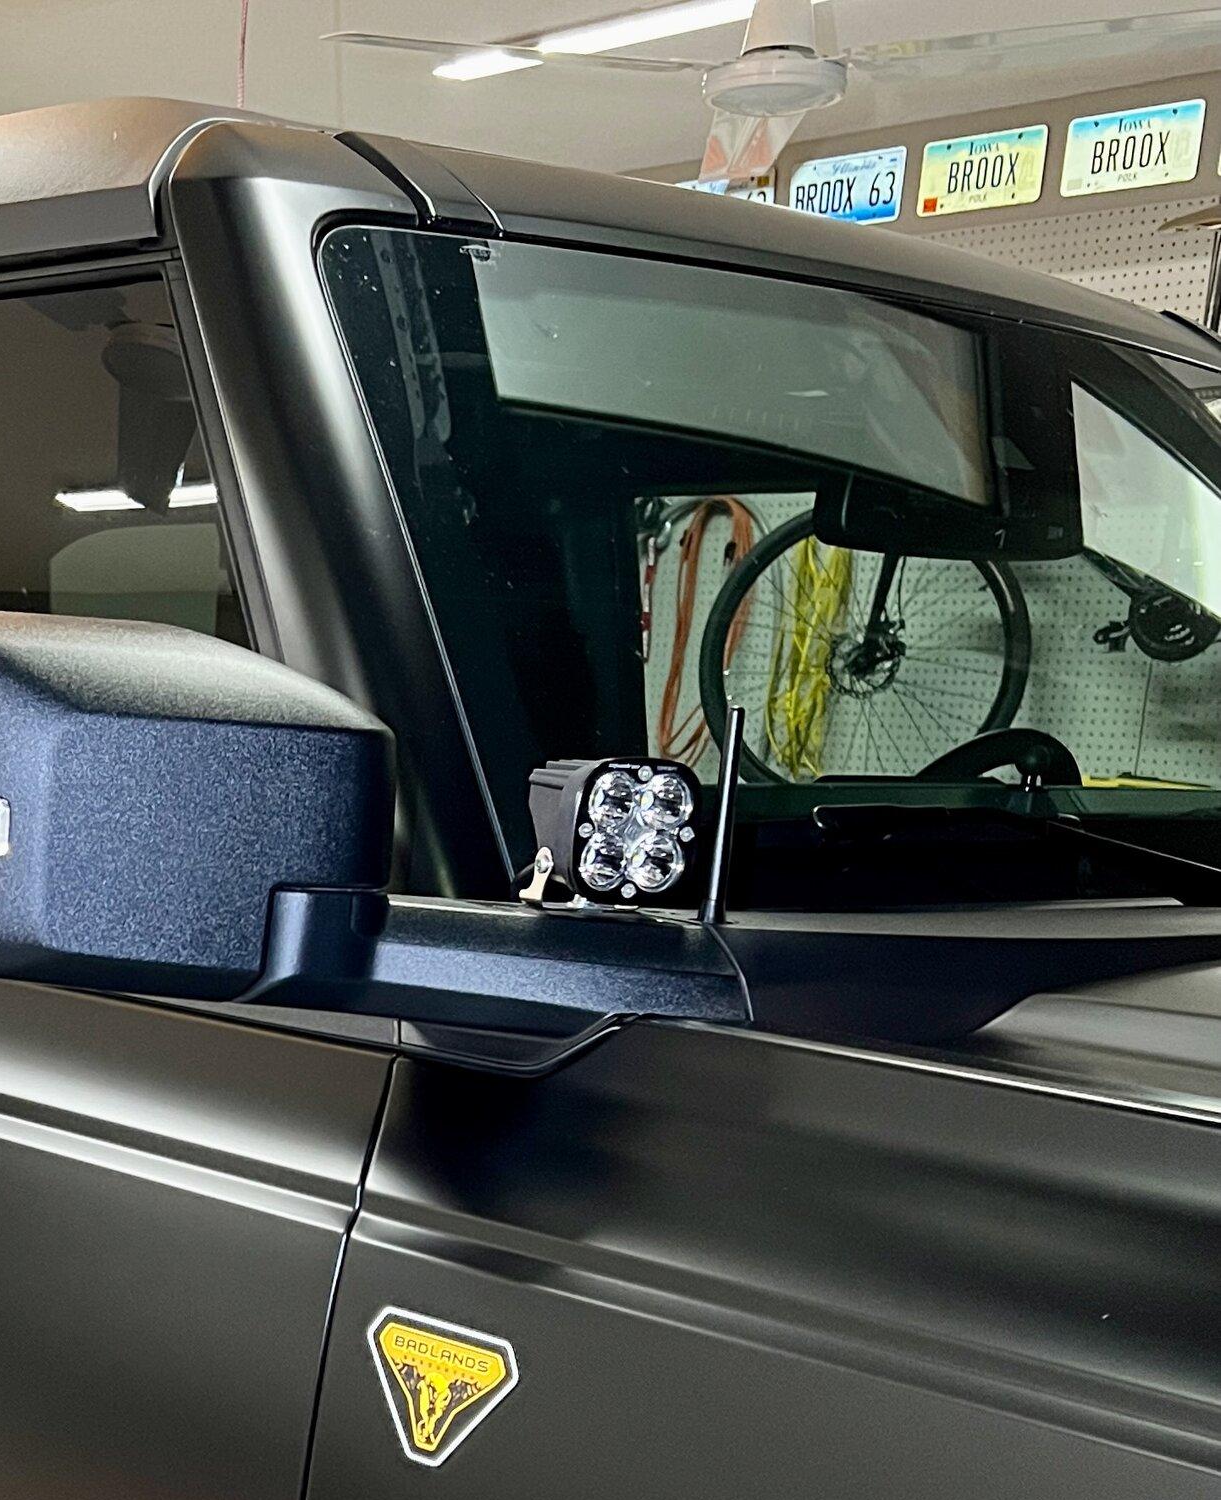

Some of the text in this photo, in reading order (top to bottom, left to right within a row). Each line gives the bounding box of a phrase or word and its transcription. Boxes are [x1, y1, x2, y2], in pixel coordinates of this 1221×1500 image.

[947, 152, 1020, 194] BROOX
[1090, 130, 1171, 175] BROOX
[795, 171, 896, 215] BROOX 63
[393, 1334, 491, 1373] BADLANDS
